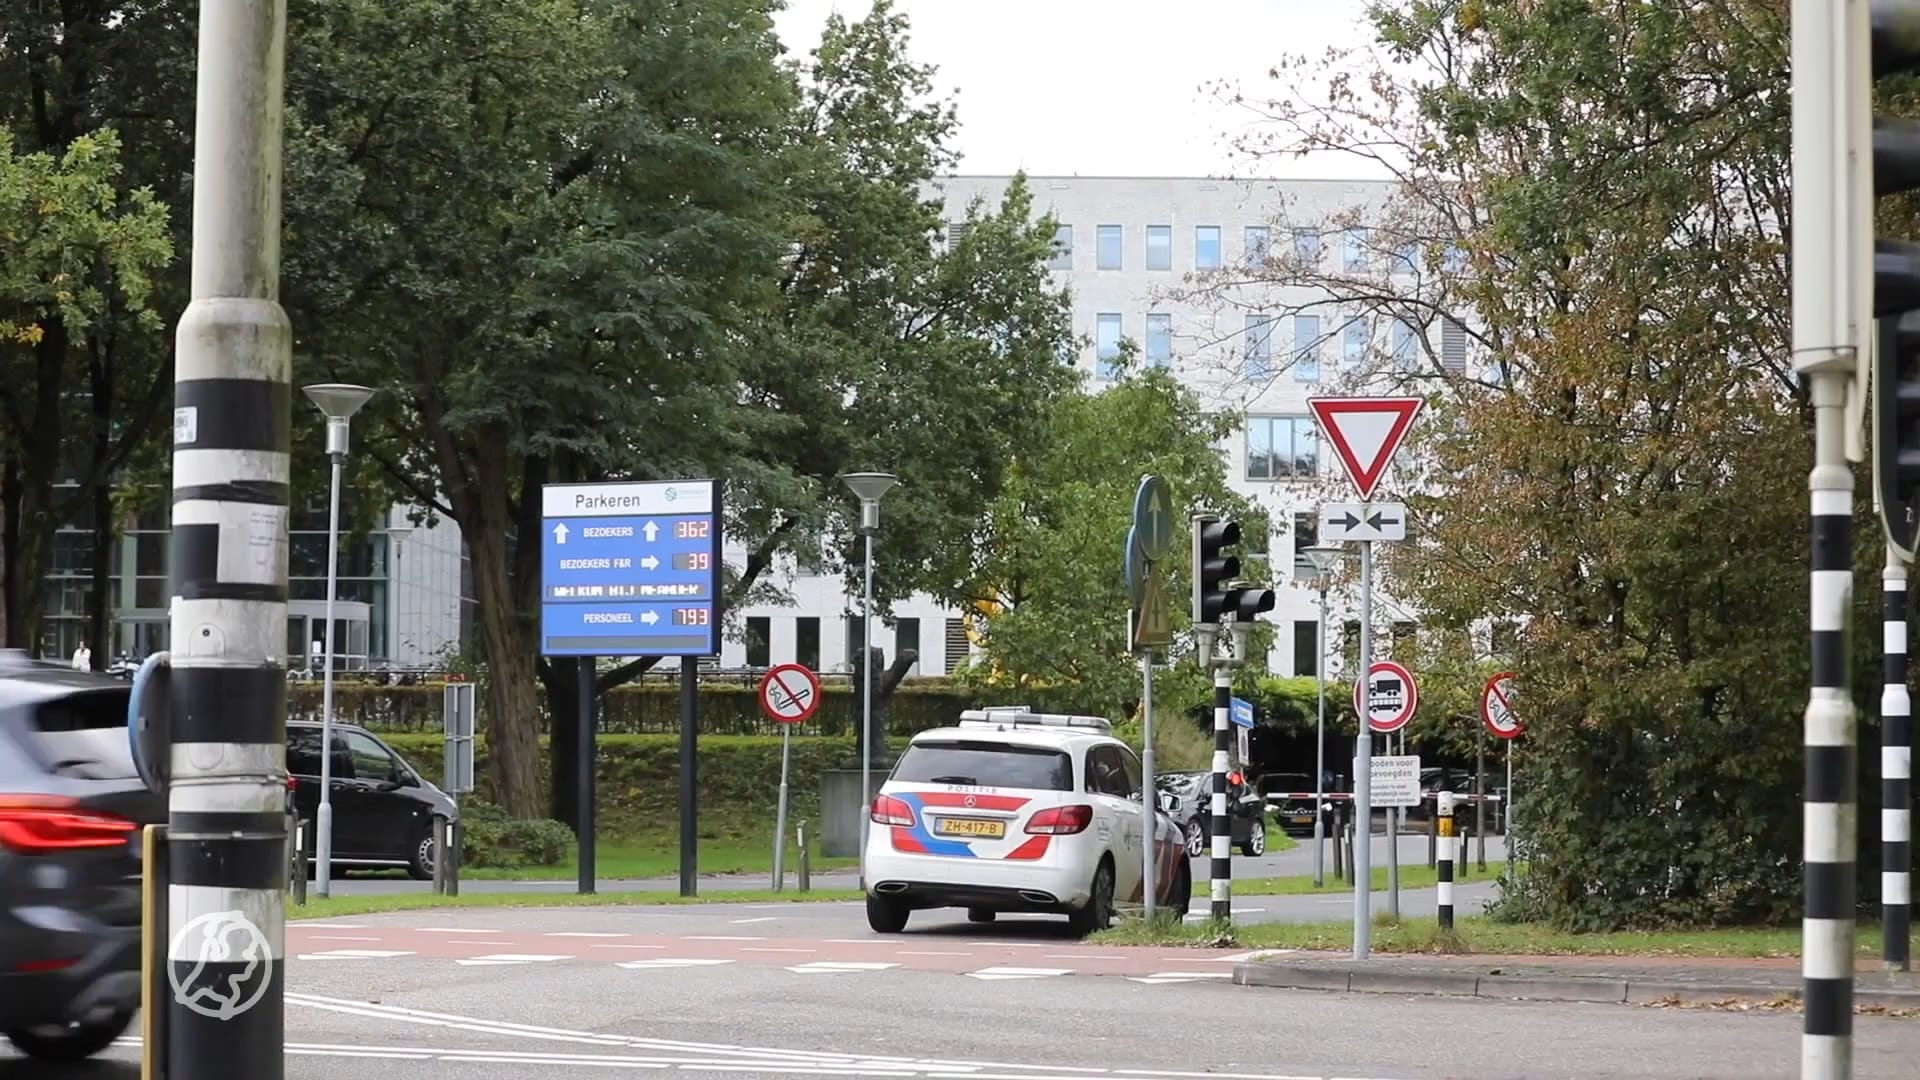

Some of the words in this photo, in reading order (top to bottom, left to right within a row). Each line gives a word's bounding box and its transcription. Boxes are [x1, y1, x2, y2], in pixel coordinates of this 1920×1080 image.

[575, 494, 641, 509] Parkeren
[583, 526, 634, 538] BEZOEKERS
[677, 521, 709, 538] 362
[560, 558, 611, 570] BEZOEKERS
[614, 557, 631, 569] F&R
[688, 553, 709, 570] 39
[583, 612, 634, 624] PERSONEEL
[677, 608, 709, 626] 793
[947, 785, 997, 794] POLITIE
[945, 820, 997, 834] ZH-417-B
